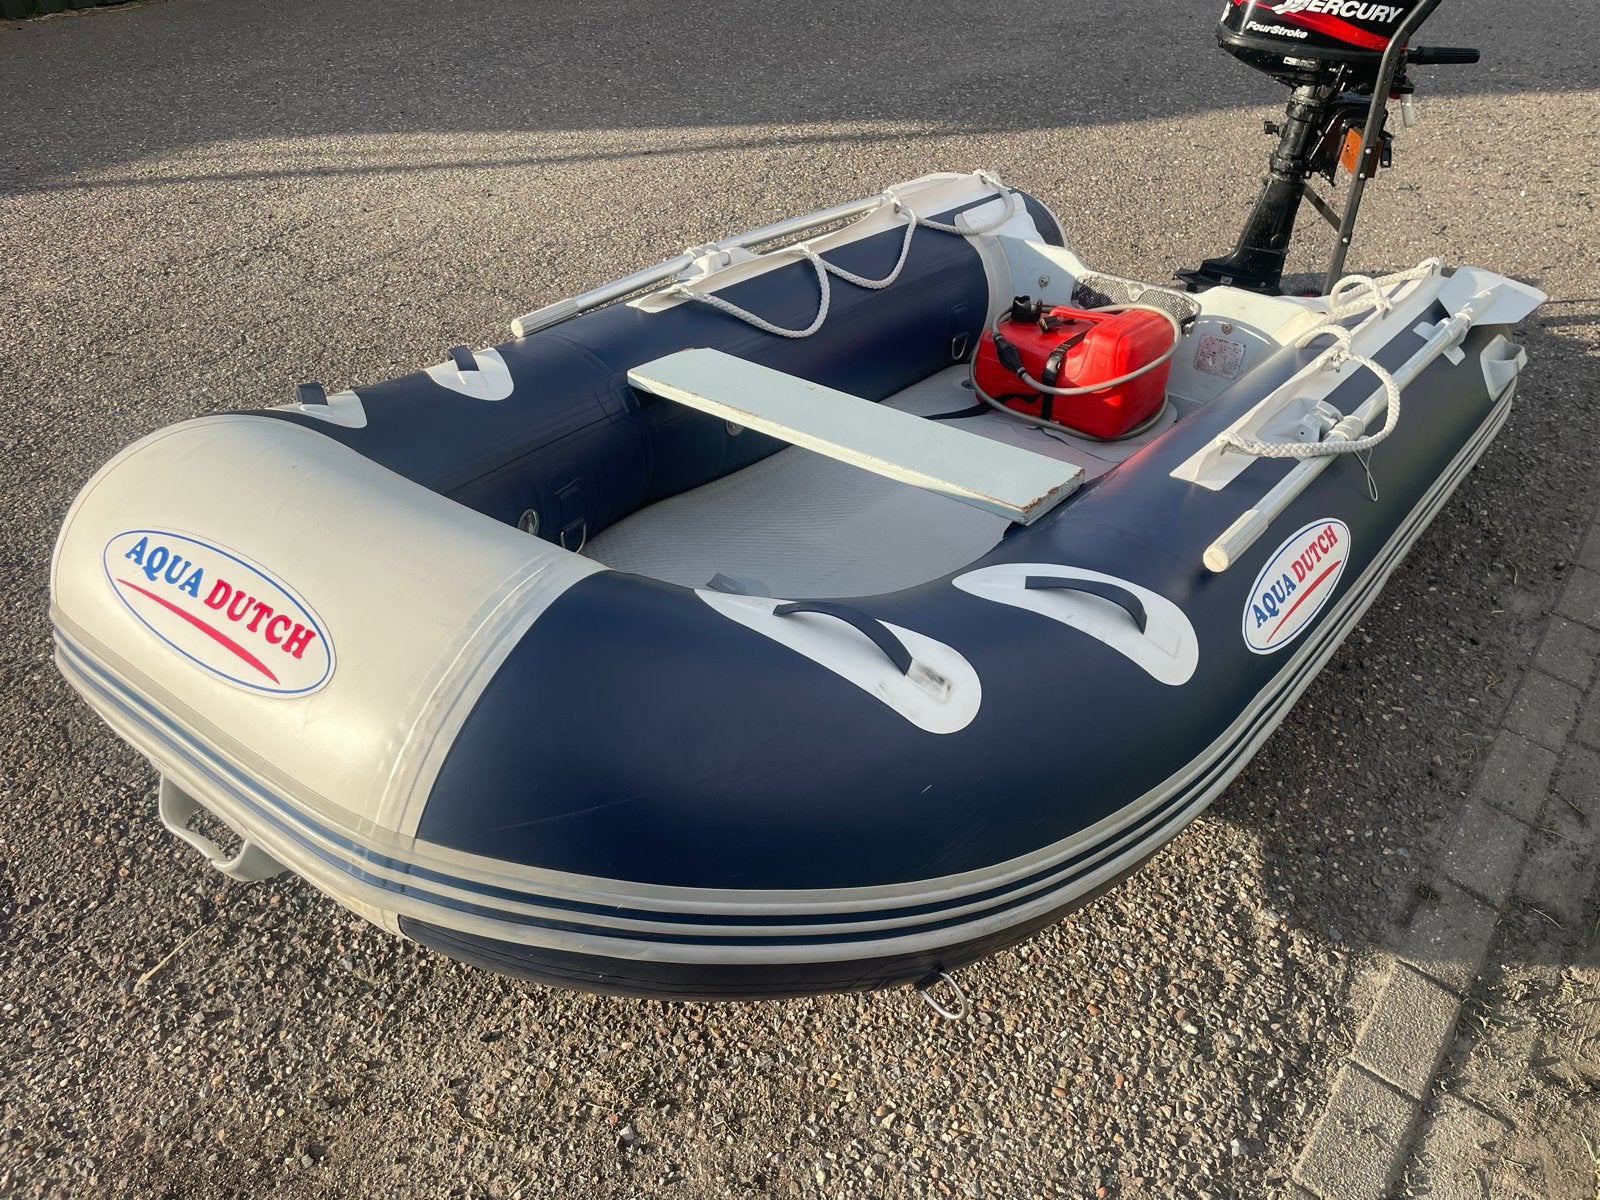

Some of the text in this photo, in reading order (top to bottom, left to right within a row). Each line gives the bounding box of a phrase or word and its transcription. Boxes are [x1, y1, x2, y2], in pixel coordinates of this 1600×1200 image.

[1246, 21, 1309, 39] FourStroke
[125, 536, 316, 660] AQUA DUTCH
[1252, 524, 1338, 628] AQUA DUTCH
